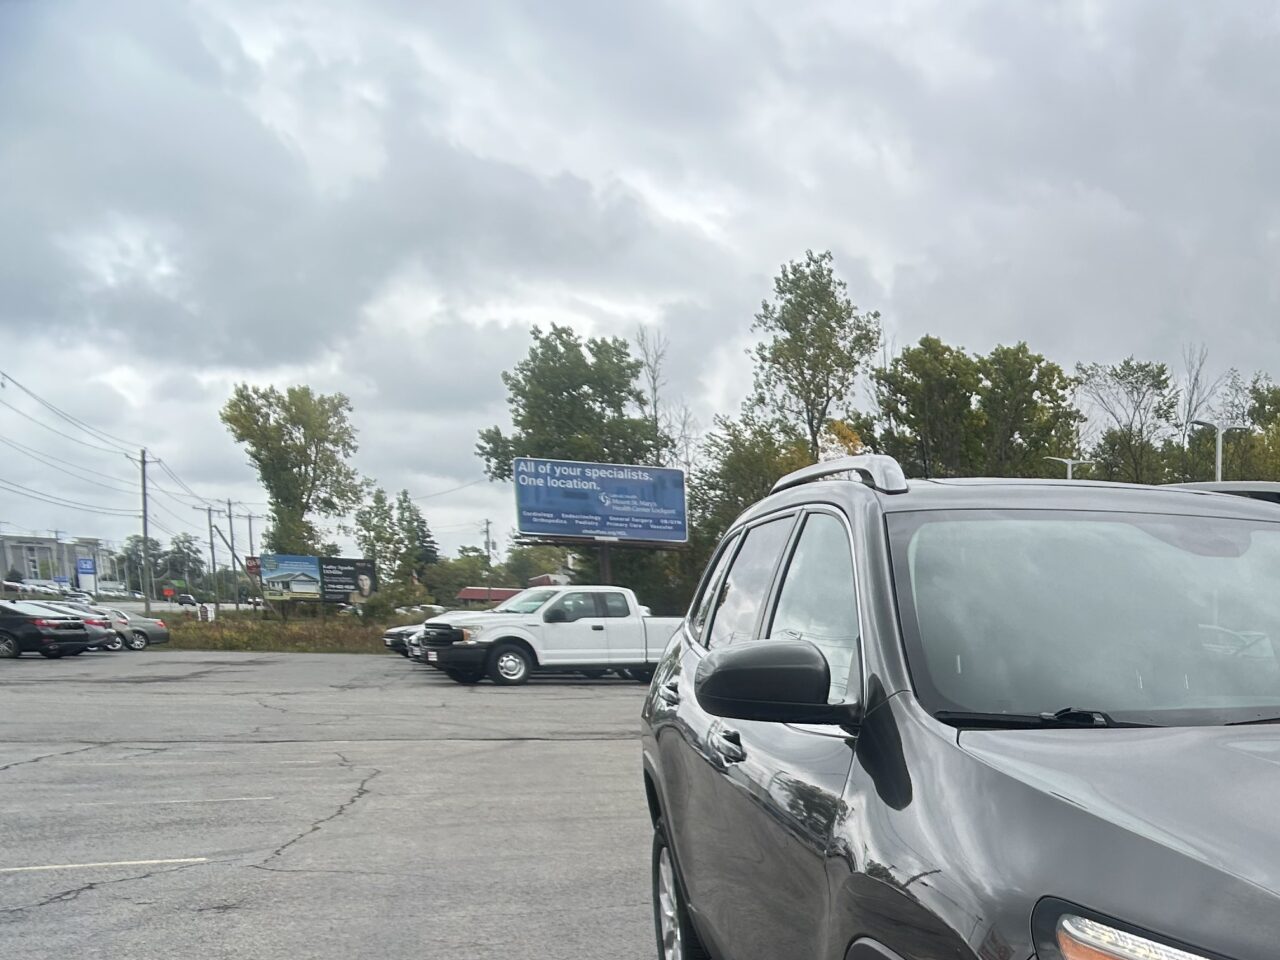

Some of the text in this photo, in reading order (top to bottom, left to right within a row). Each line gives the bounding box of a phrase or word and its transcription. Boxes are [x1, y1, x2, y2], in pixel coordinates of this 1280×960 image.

[518, 461, 653, 480] All of your specialists.
[519, 474, 600, 490] One location.
